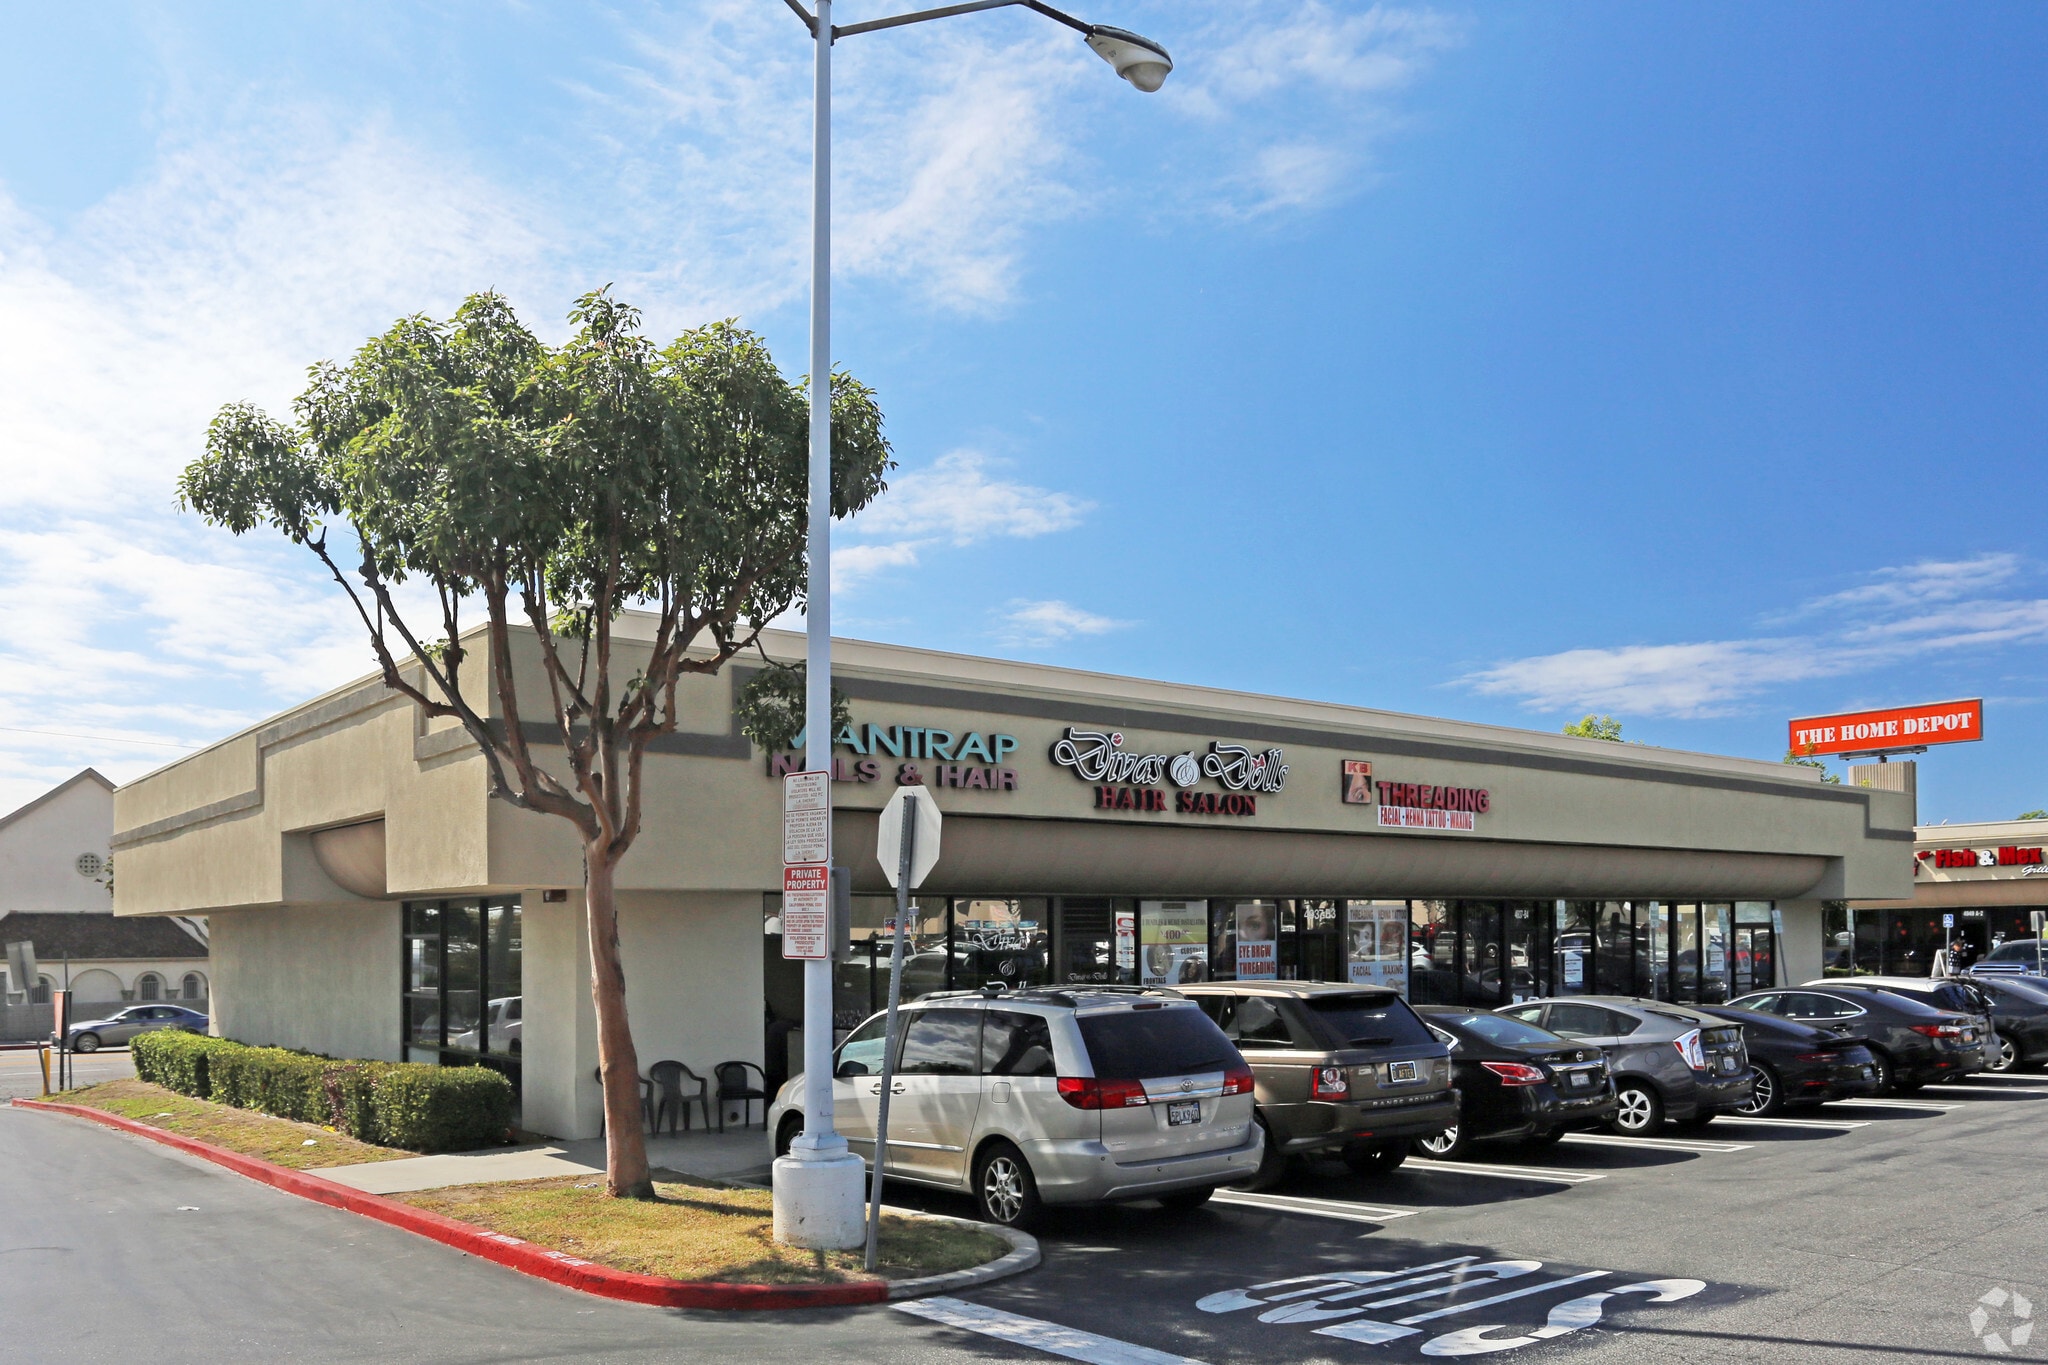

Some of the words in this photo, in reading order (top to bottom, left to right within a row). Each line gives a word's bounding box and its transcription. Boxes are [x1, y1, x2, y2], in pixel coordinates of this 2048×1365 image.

[1796, 727, 1835, 746] THE
[1841, 720, 1898, 741] HOME
[1903, 712, 1972, 735] DEPOT
[767, 752, 881, 783] NILS
[937, 765, 1018, 790] HAIR
[1049, 727, 1167, 784] Divas
[1199, 741, 1290, 794] Dolls
[1095, 785, 1167, 812] HAIR
[1176, 790, 1258, 816] SALON
[1377, 781, 1490, 813] THREADING
[1380, 806, 1401, 826] FACIAL
[1425, 811, 1446, 828] TATTOO
[1450, 812, 1473, 830] WAXING
[1979, 850, 1994, 866] &
[1997, 846, 2043, 866] Mex
[786, 879, 825, 889] PROPERTY
[791, 869, 821, 879] PRIVATE
[1239, 944, 1250, 959] EYE
[1239, 960, 1276, 976] THREADING
